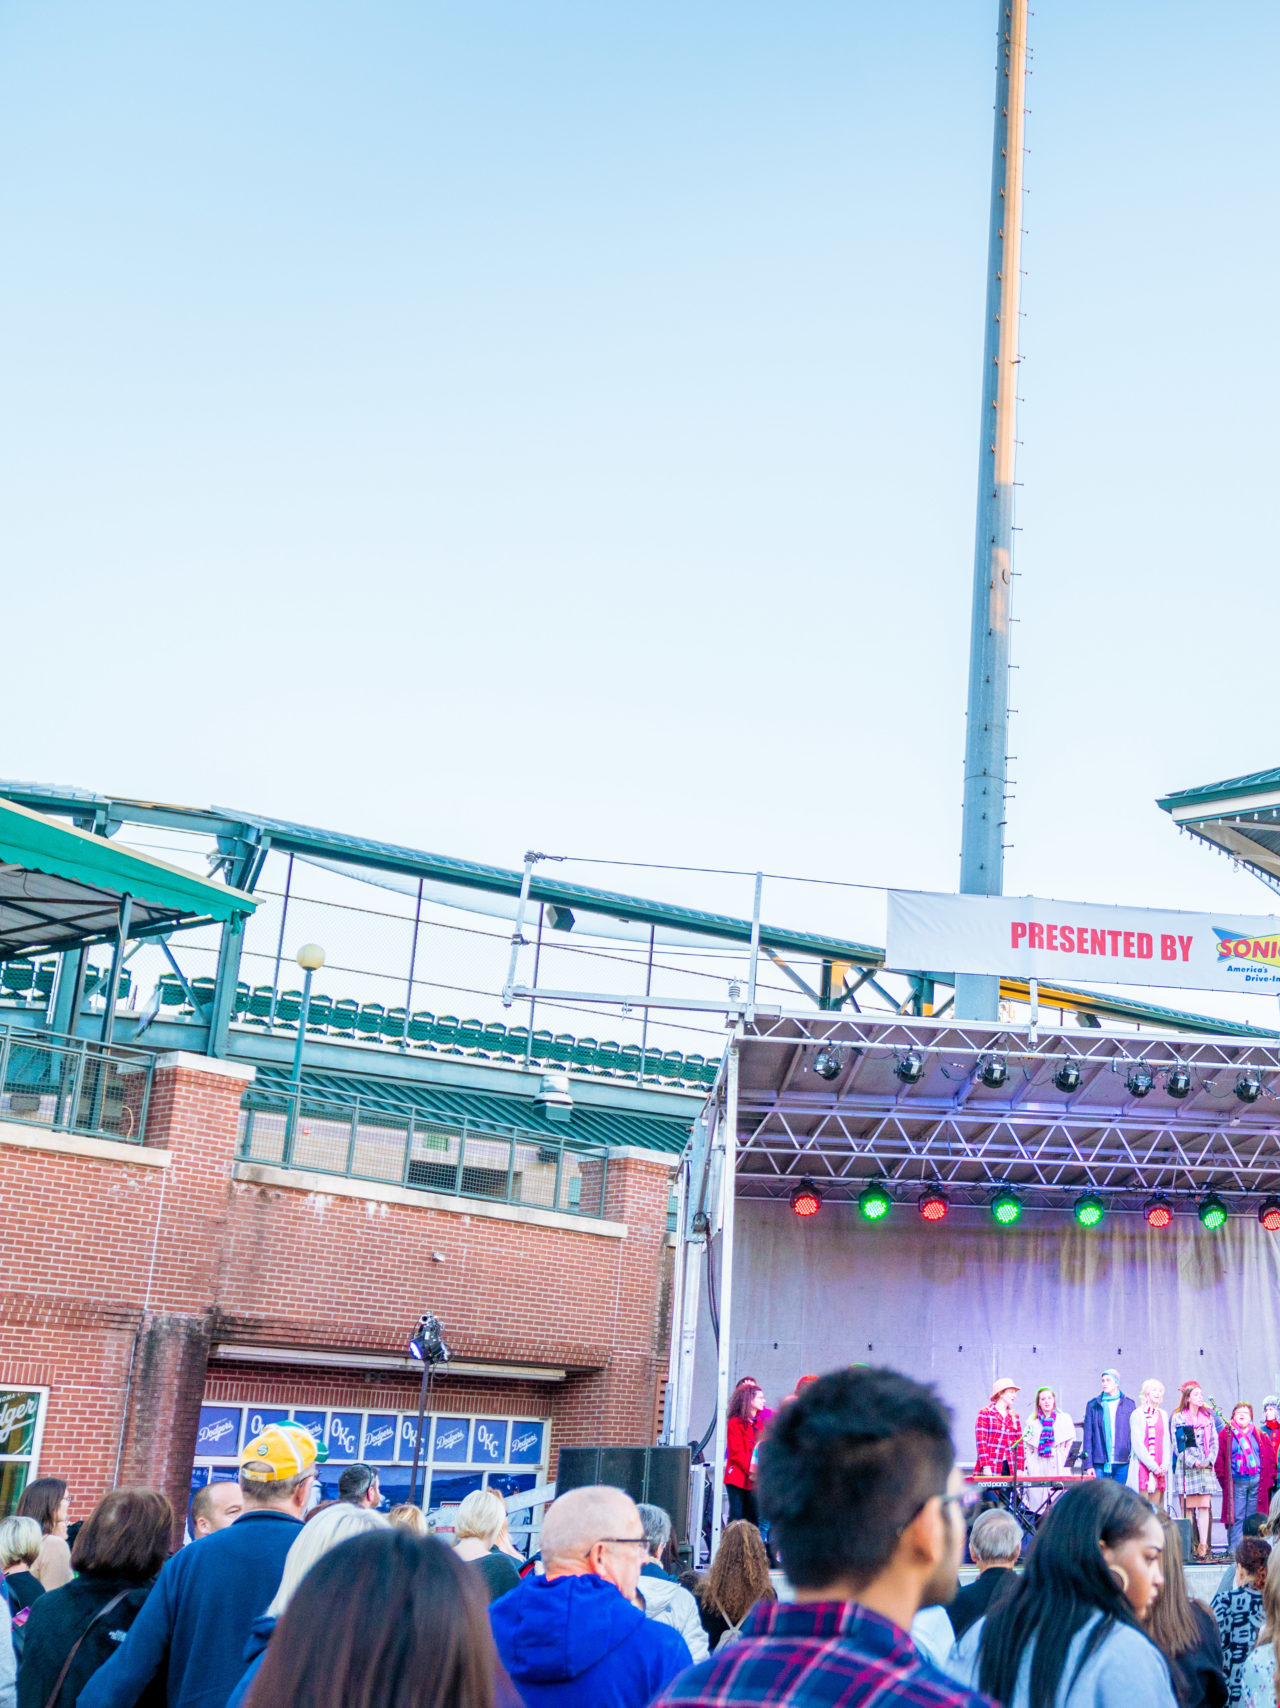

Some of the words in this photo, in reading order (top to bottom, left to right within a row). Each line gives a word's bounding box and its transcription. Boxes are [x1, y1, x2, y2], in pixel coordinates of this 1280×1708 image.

[1011, 921, 1152, 959] PRESENTED
[1161, 934, 1193, 962] BY
[1226, 965, 1268, 973] America's
[1245, 974, 1280, 983] Drive-In
[198, 1420, 234, 1442] Dodgers
[331, 1418, 355, 1453] OKC
[364, 1426, 394, 1447] Dodgers
[436, 1430, 464, 1450] Dodgers
[477, 1425, 498, 1458] OKC
[511, 1434, 538, 1453] Dodgers
